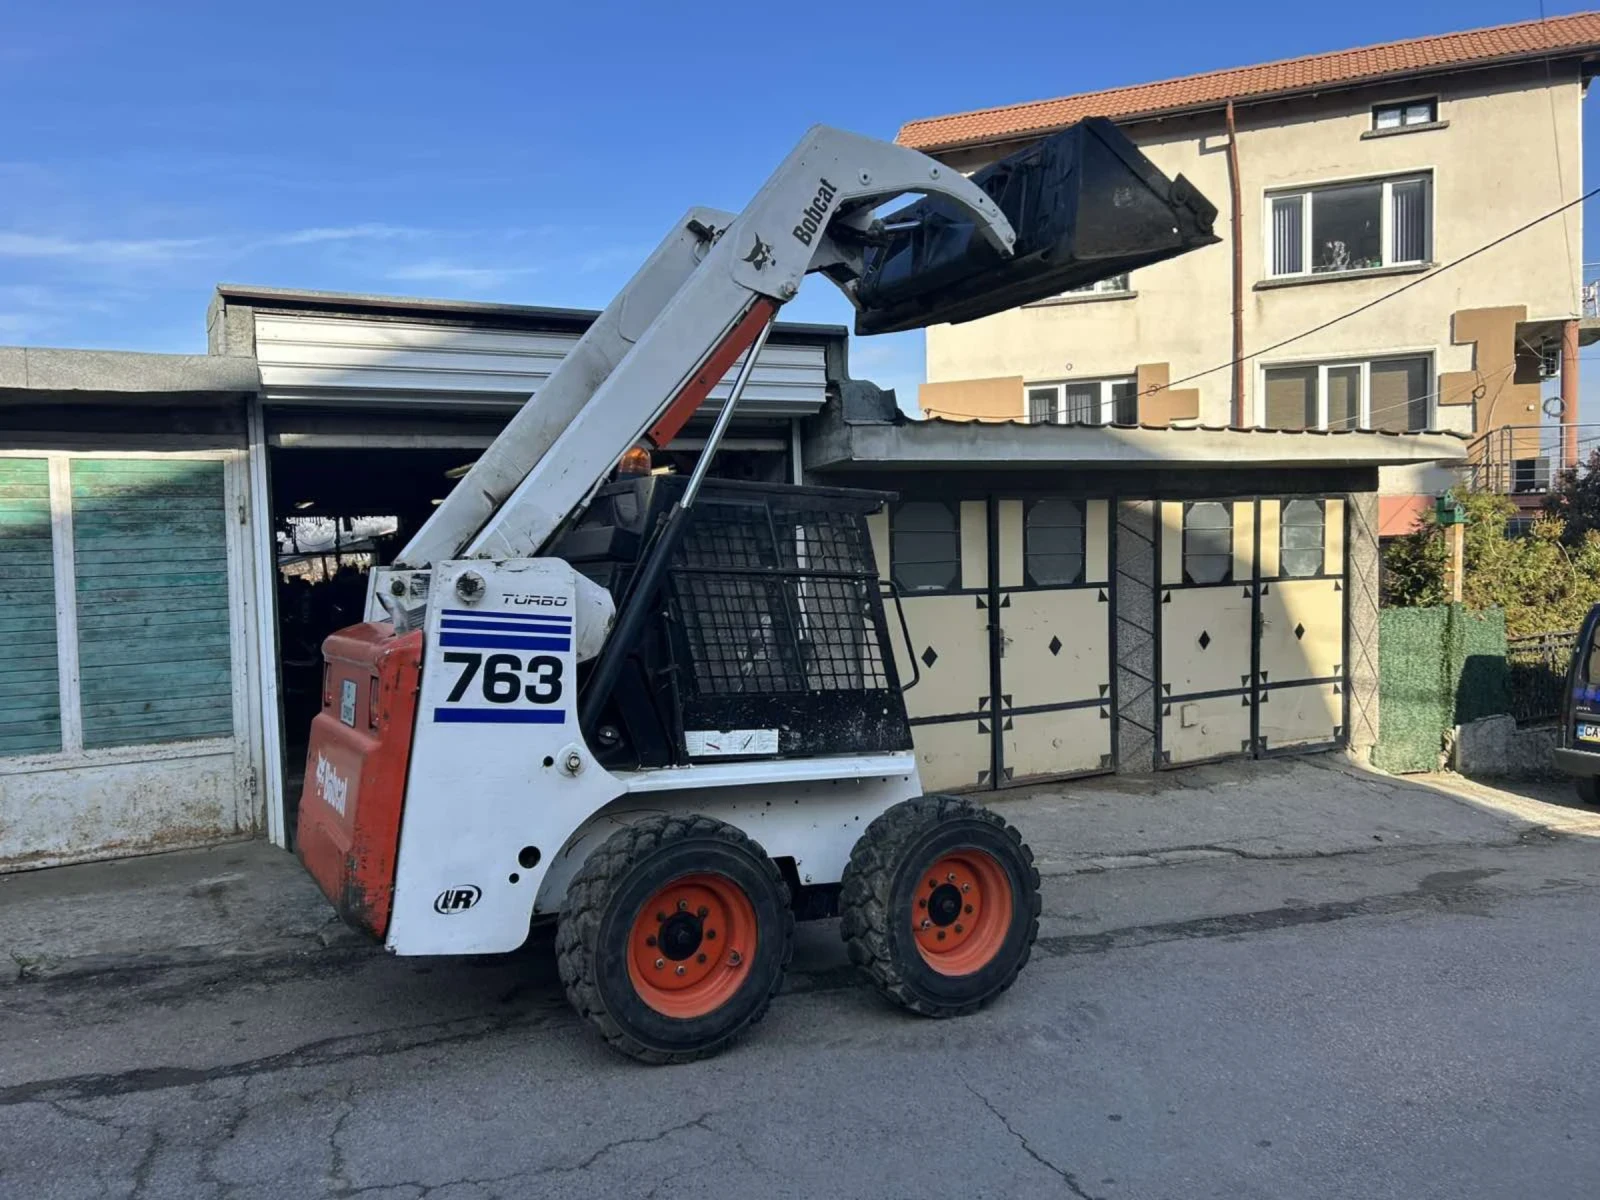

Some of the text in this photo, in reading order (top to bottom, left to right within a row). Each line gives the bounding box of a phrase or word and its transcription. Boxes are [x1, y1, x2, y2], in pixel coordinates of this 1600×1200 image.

[792, 177, 837, 247] Bobcat
[502, 593, 568, 606] TURBO
[443, 652, 564, 705] 763
